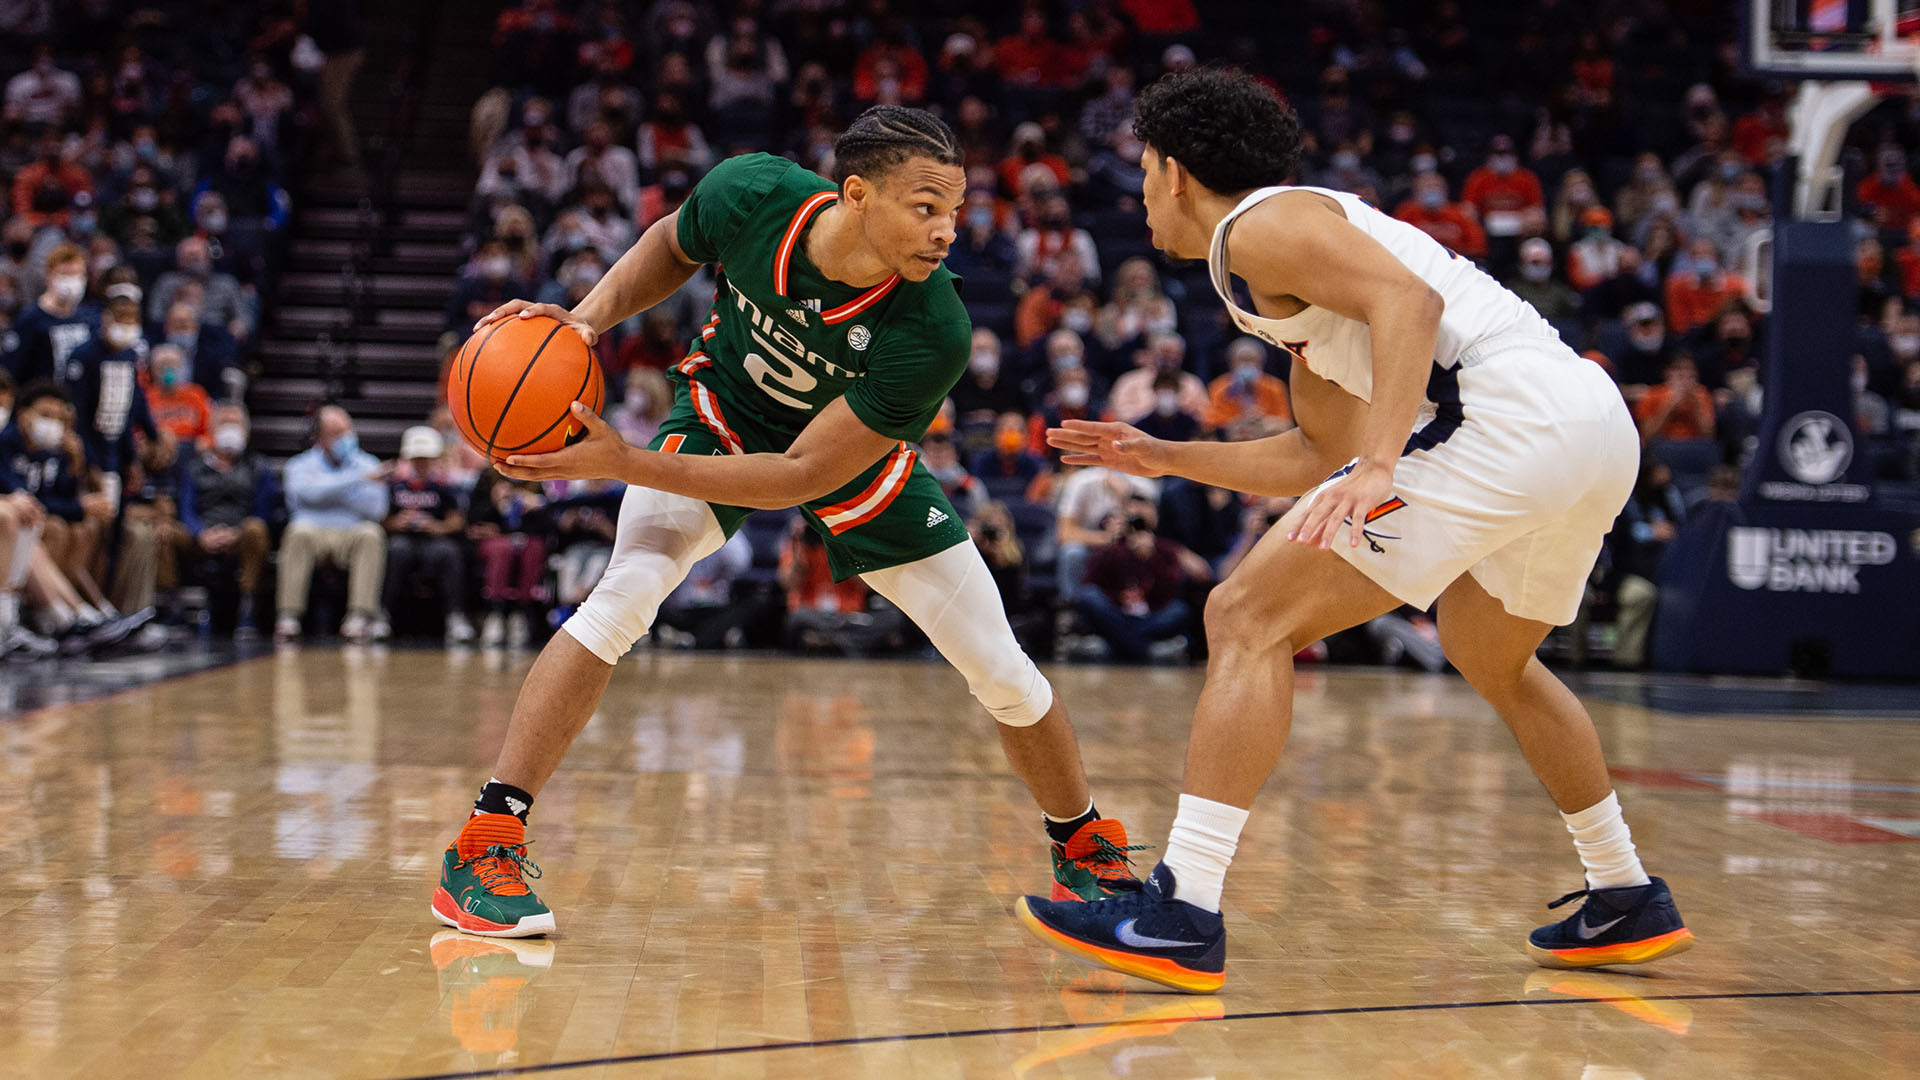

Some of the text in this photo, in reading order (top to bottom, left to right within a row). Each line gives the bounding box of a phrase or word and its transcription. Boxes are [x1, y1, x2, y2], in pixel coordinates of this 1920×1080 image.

[743, 329, 817, 409] 2
[926, 513, 949, 528] adidas
[1770, 528, 1897, 565] UNITED
[1768, 559, 1861, 594] BANK
